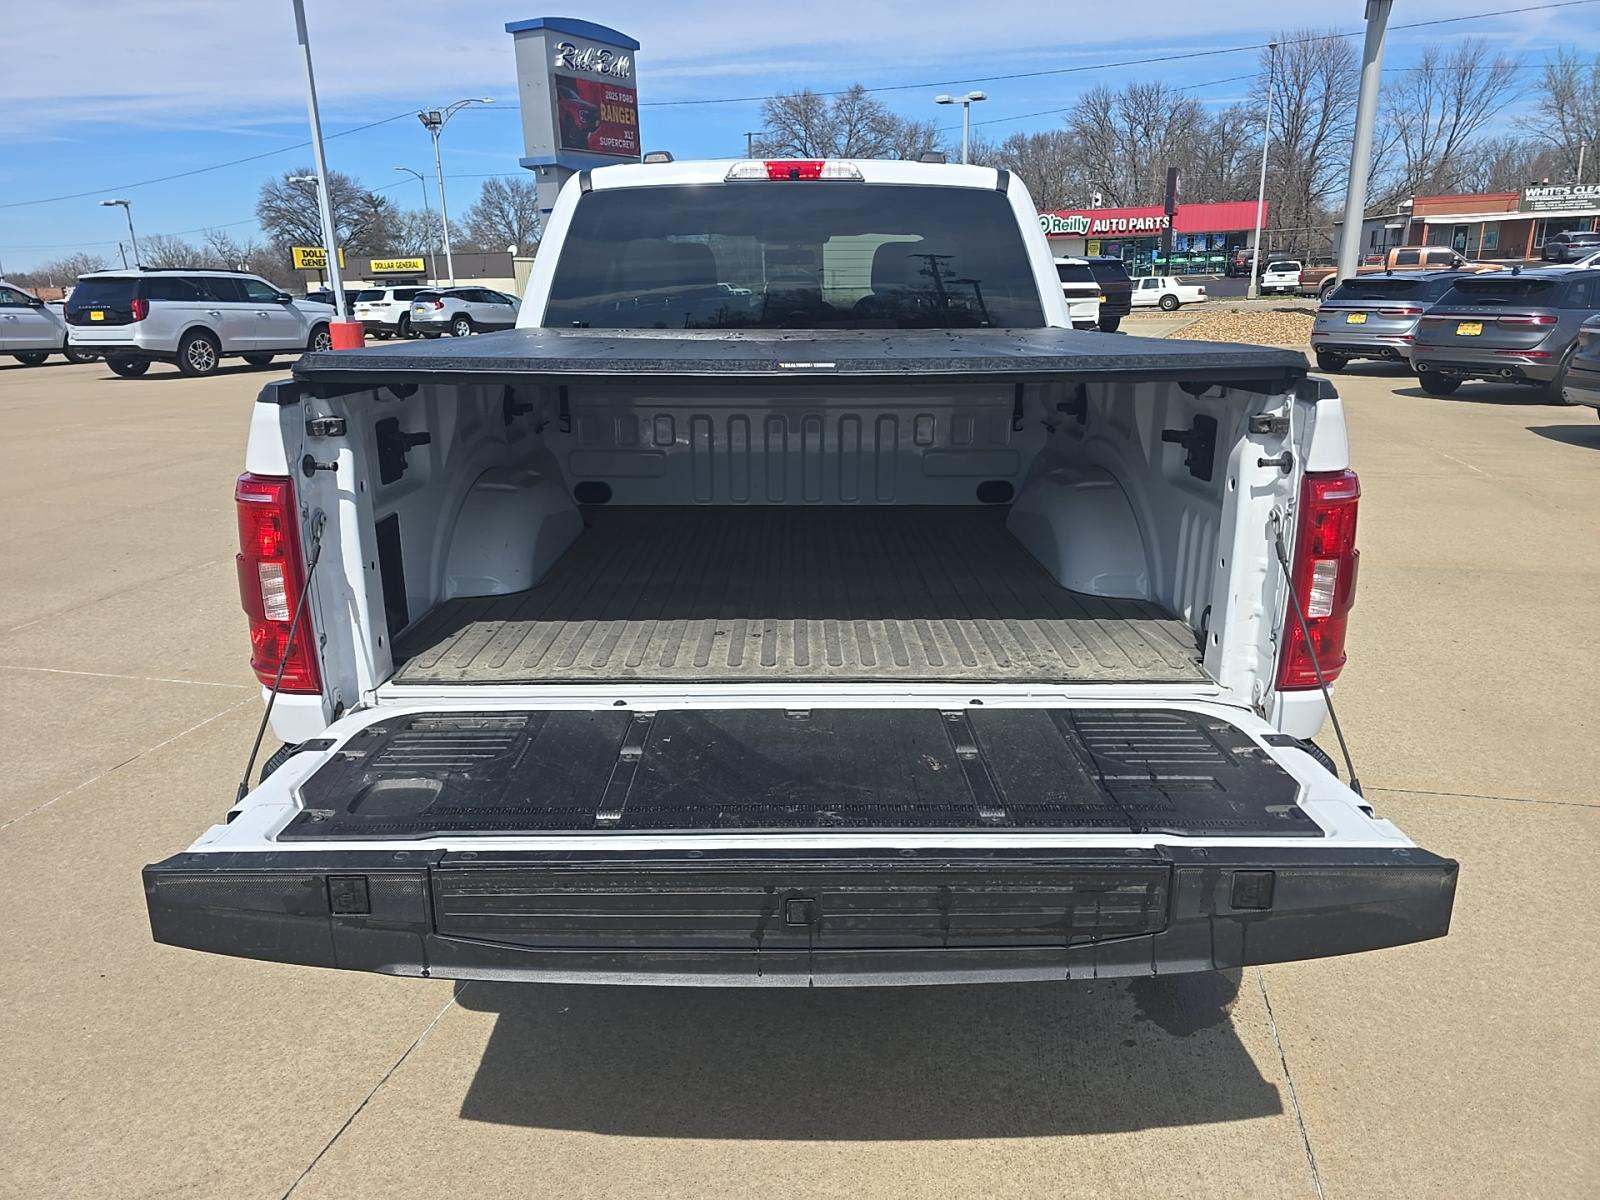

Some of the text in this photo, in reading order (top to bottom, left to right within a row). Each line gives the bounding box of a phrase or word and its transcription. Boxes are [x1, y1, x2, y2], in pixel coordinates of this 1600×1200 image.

[605, 91, 633, 104] 2025 FORD
[601, 103, 636, 126] RANGER
[624, 130, 634, 140] XLT
[600, 136, 634, 149] SUPERCREW
[1040, 214, 1170, 234] O'Reilly AUTO PARTS
[302, 249, 326, 258] DOLL
[374, 260, 419, 269] DOLLAR GENERAL
